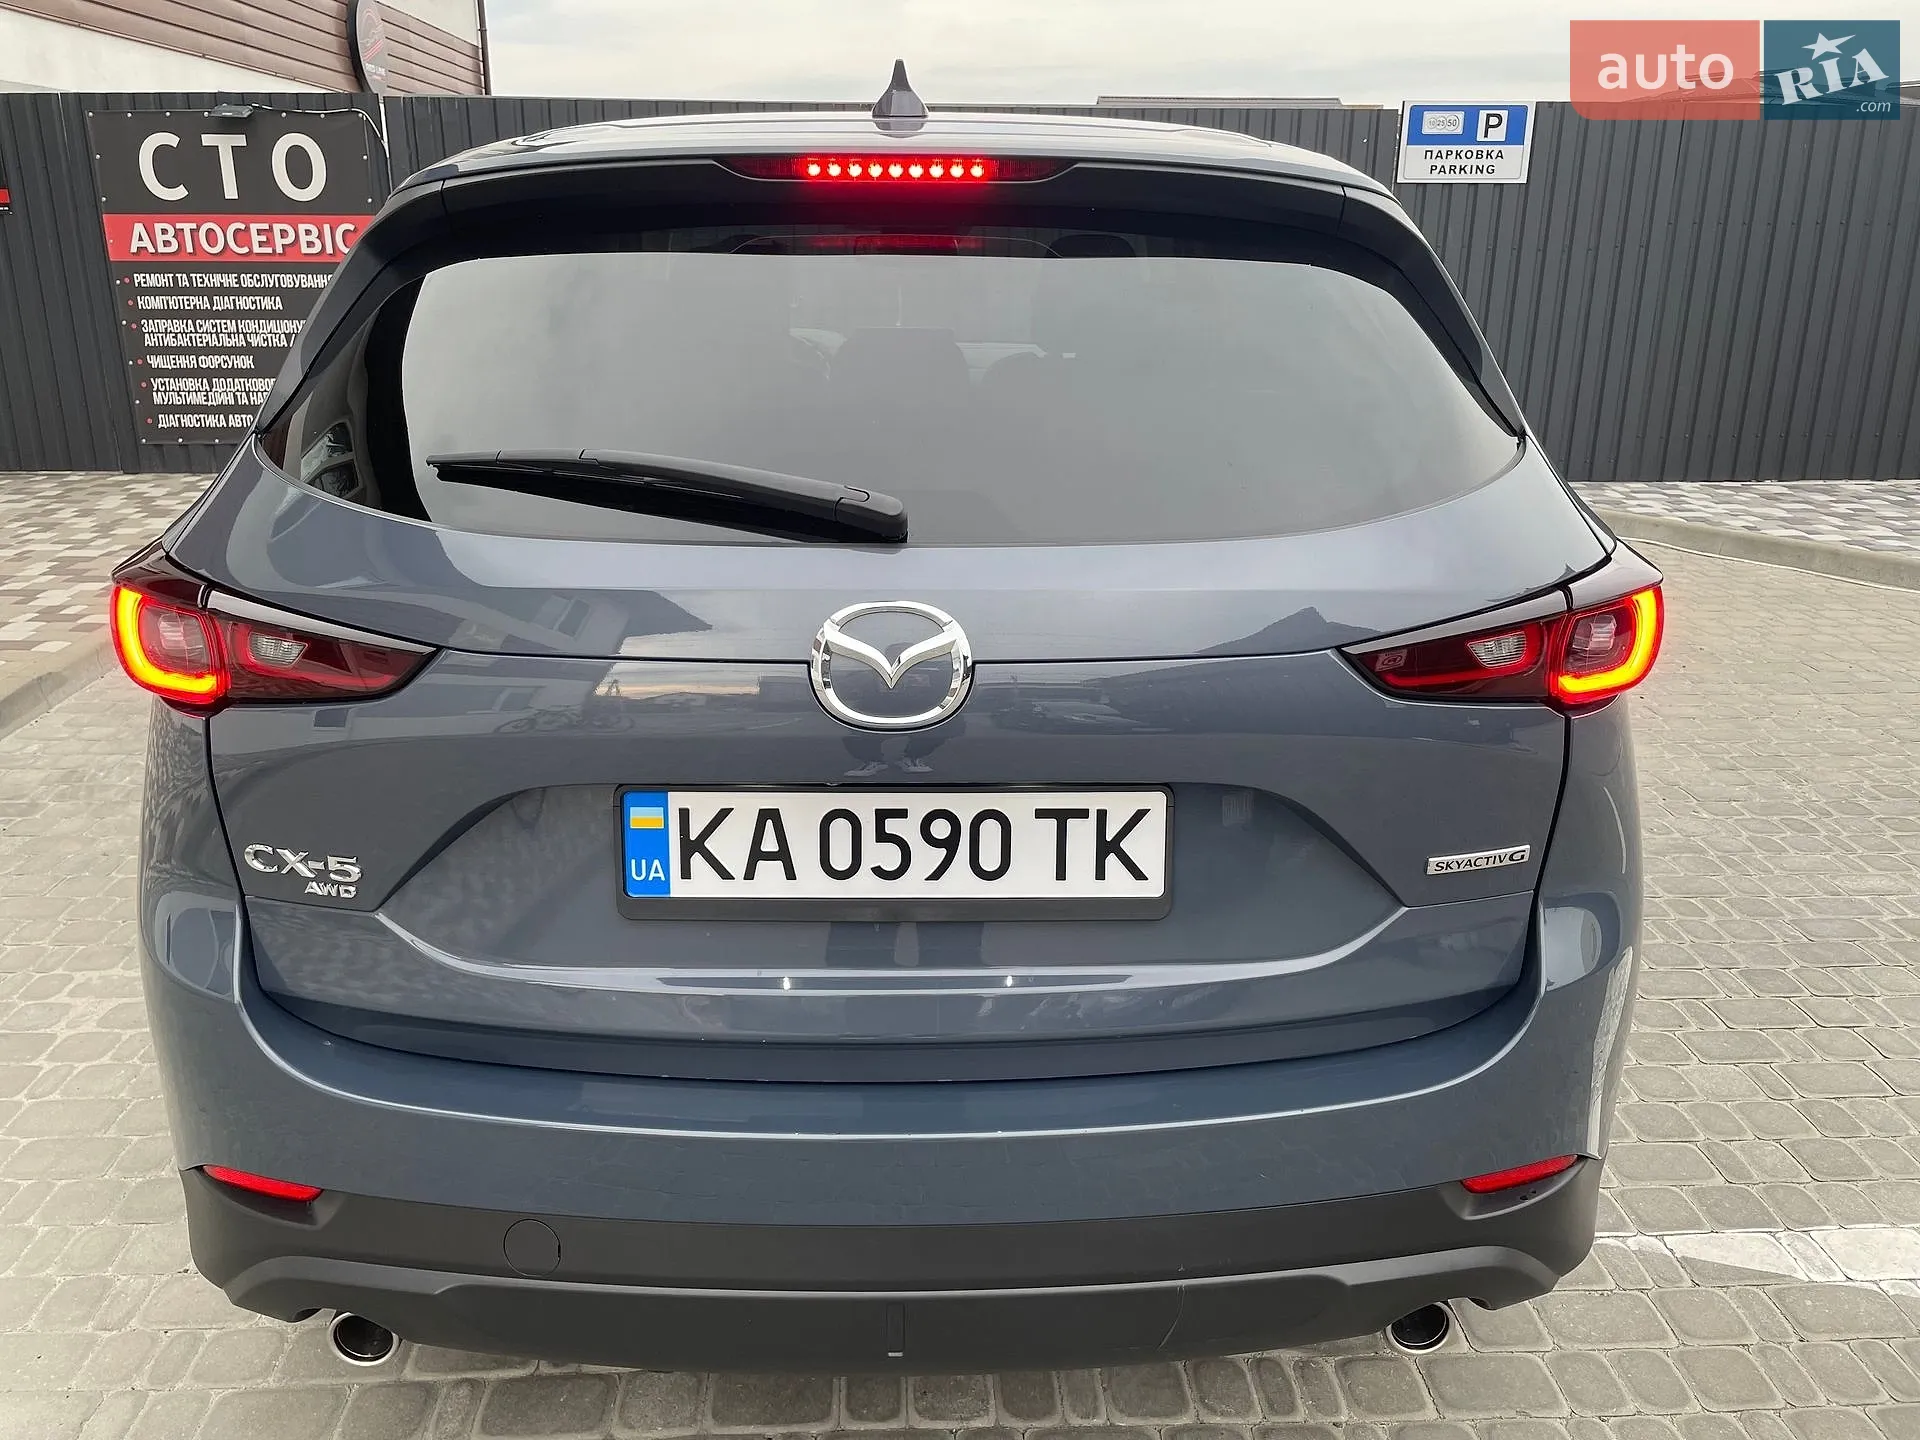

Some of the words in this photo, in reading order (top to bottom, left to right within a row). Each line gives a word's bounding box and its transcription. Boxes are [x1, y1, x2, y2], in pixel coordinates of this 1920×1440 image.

[1484, 113, 1503, 138] P
[1424, 150, 1504, 160] ПАРКОВКА
[1429, 165, 1496, 175] PARKING
[129, 222, 357, 256] АВТОСЕРВІС
[133, 273, 174, 288] РЕМОНТ
[175, 273, 190, 288] ТА
[190, 273, 240, 288] ТЕХНІЧНЕ
[212, 296, 283, 312] ДІАГНОСТИКА
[141, 319, 195, 334] ЗАПРАВКА
[196, 319, 237, 334] СИСТЕМ
[238, 319, 307, 334] КОНДИЦІОНУ
[144, 333, 247, 348] АНТИБАКТЕРІАЛЬНА
[247, 333, 289, 348] ЧИСТКА
[147, 354, 197, 370] ЧИЩЕННЯ
[198, 355, 255, 369] ФОРСУНОК
[150, 378, 209, 392] УСТАНОВКА
[236, 391, 250, 406] ТА
[158, 414, 227, 429] ДІАГНОСТИКА
[678, 807, 798, 881] KA
[818, 808, 1012, 882] 0590
[1034, 807, 1152, 881] TK
[244, 843, 362, 882] CX-5
[630, 859, 666, 881] UA
[304, 881, 358, 899] AWD
